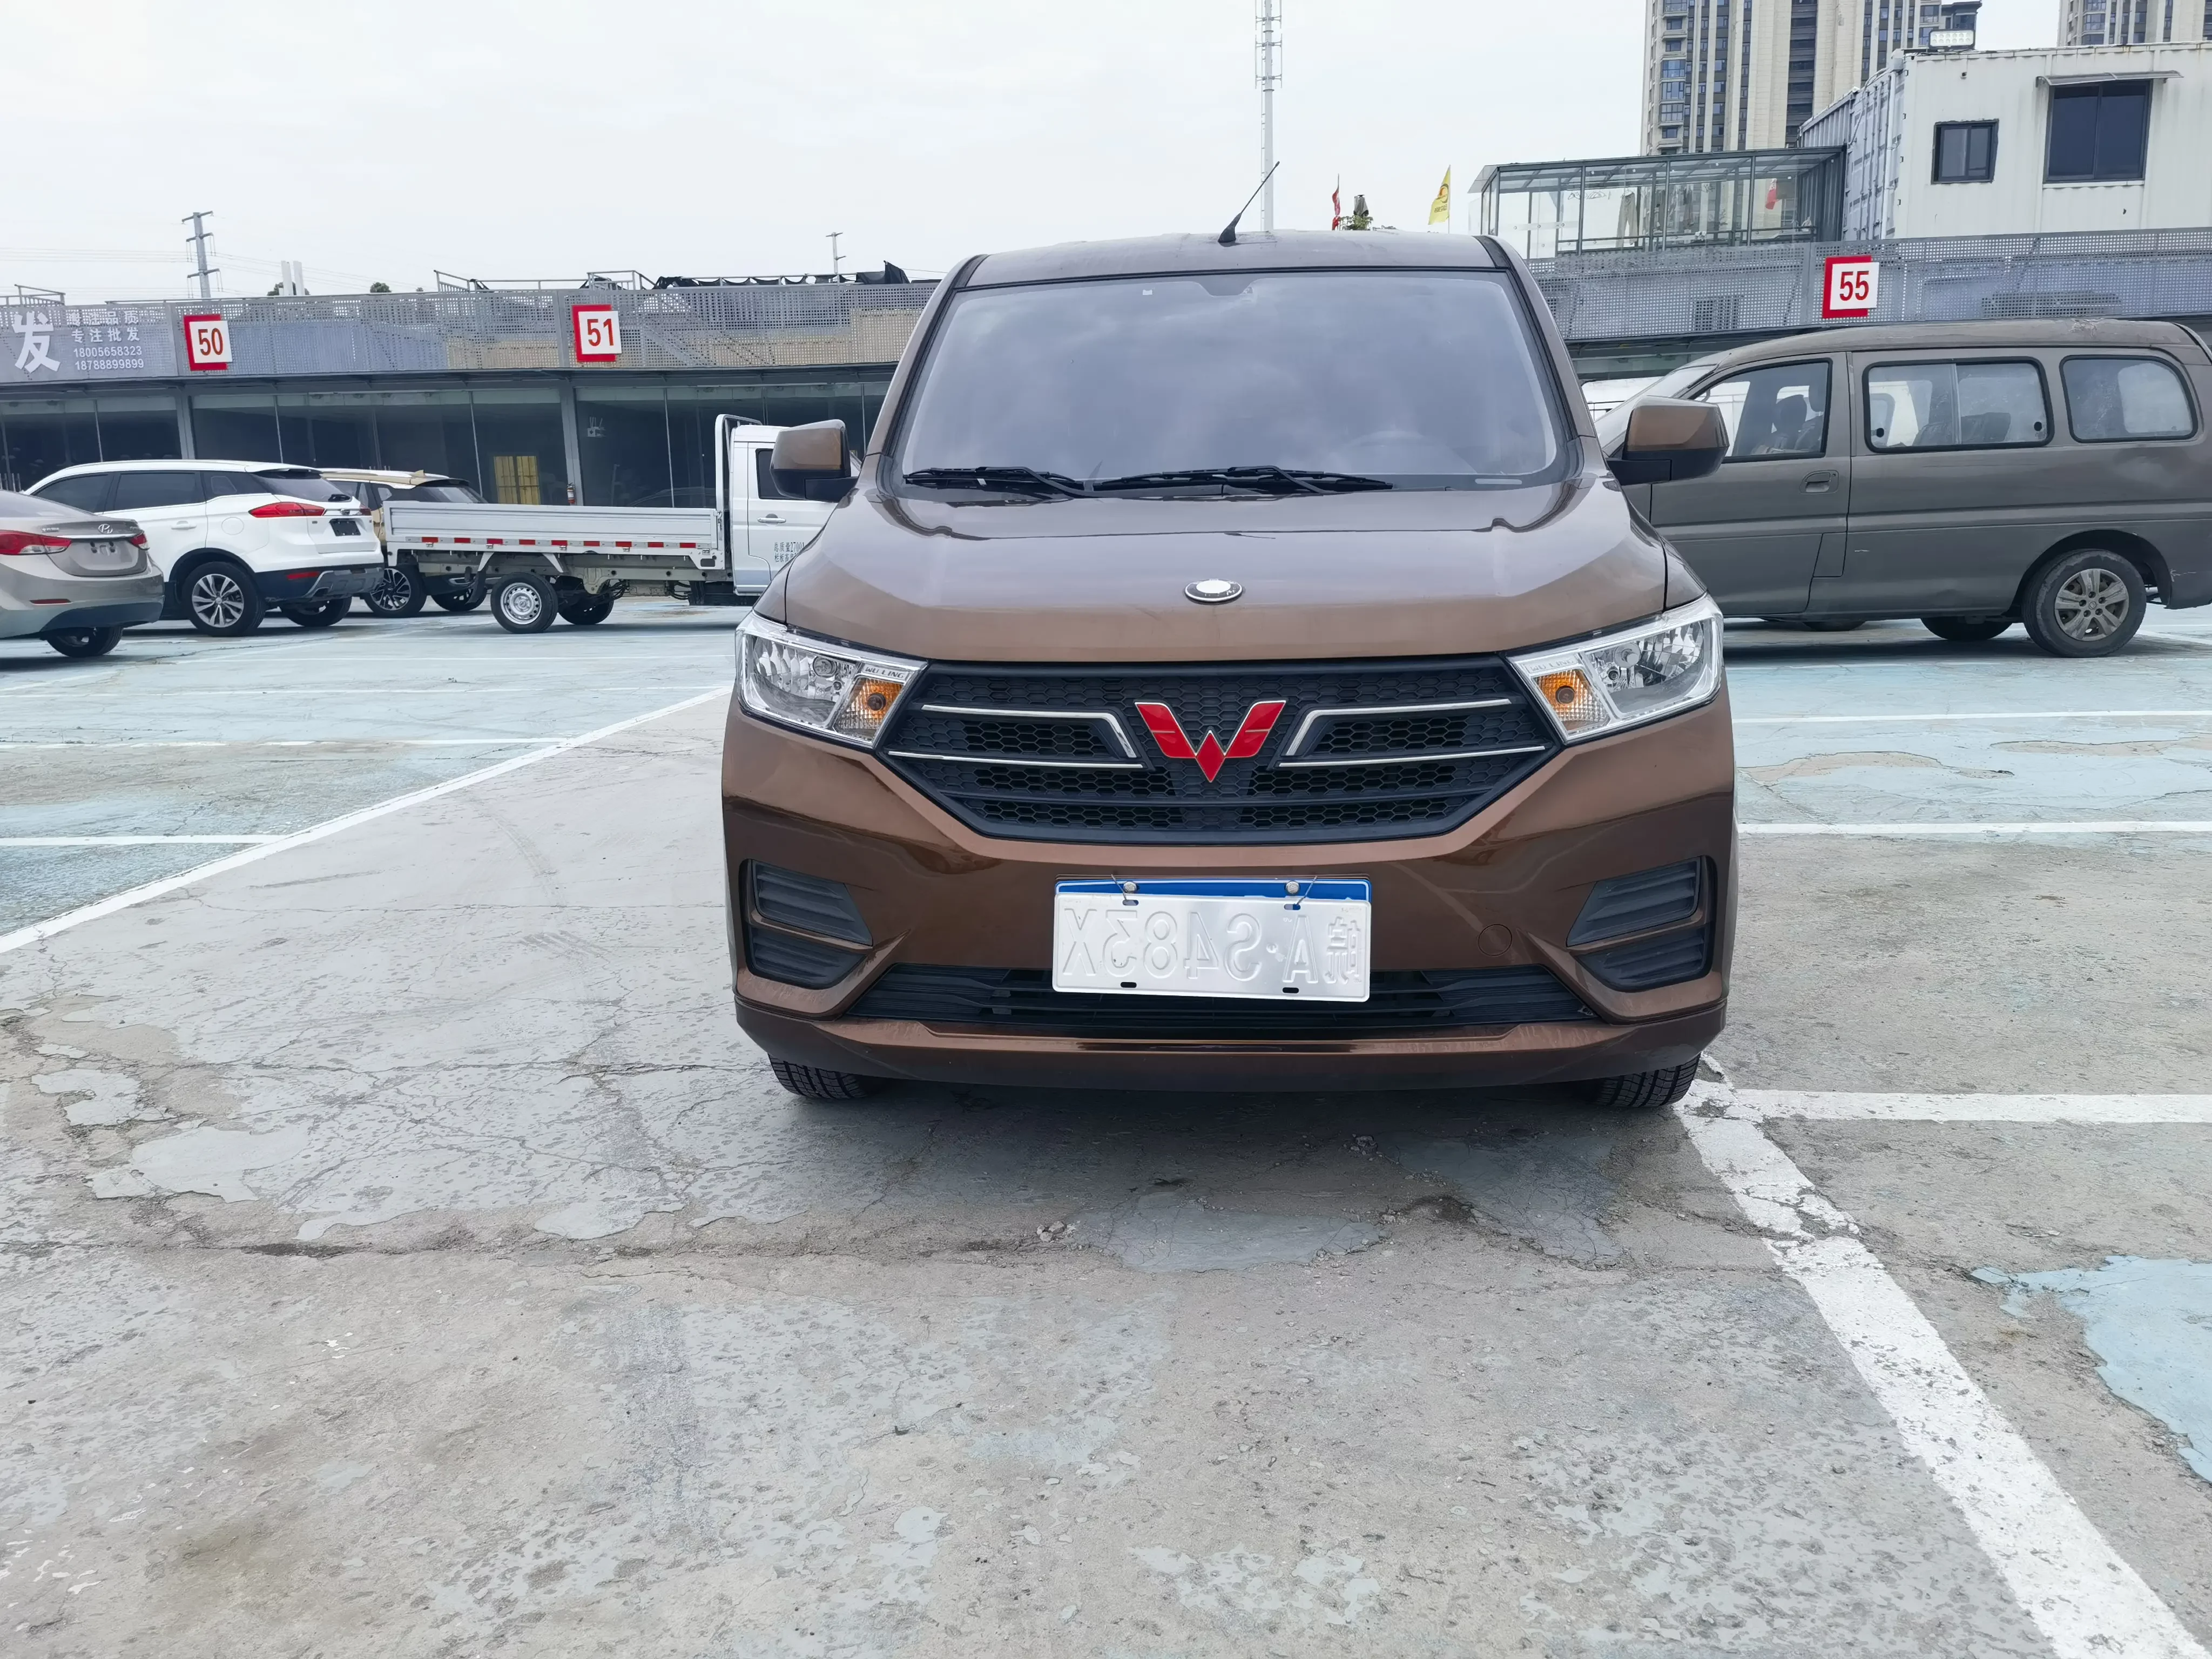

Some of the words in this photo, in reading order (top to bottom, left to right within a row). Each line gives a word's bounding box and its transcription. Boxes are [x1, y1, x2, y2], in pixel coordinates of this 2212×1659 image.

[1839, 271, 1869, 301] 55
[70, 310, 138, 326] 专注品质
[71, 327, 140, 343] 专注批发
[587, 319, 614, 346] 51
[12, 311, 60, 373] 发
[198, 328, 223, 355] 50
[73, 346, 142, 358] 18005658323
[75, 359, 144, 370] 18788899899
[882, 670, 905, 678] LING
